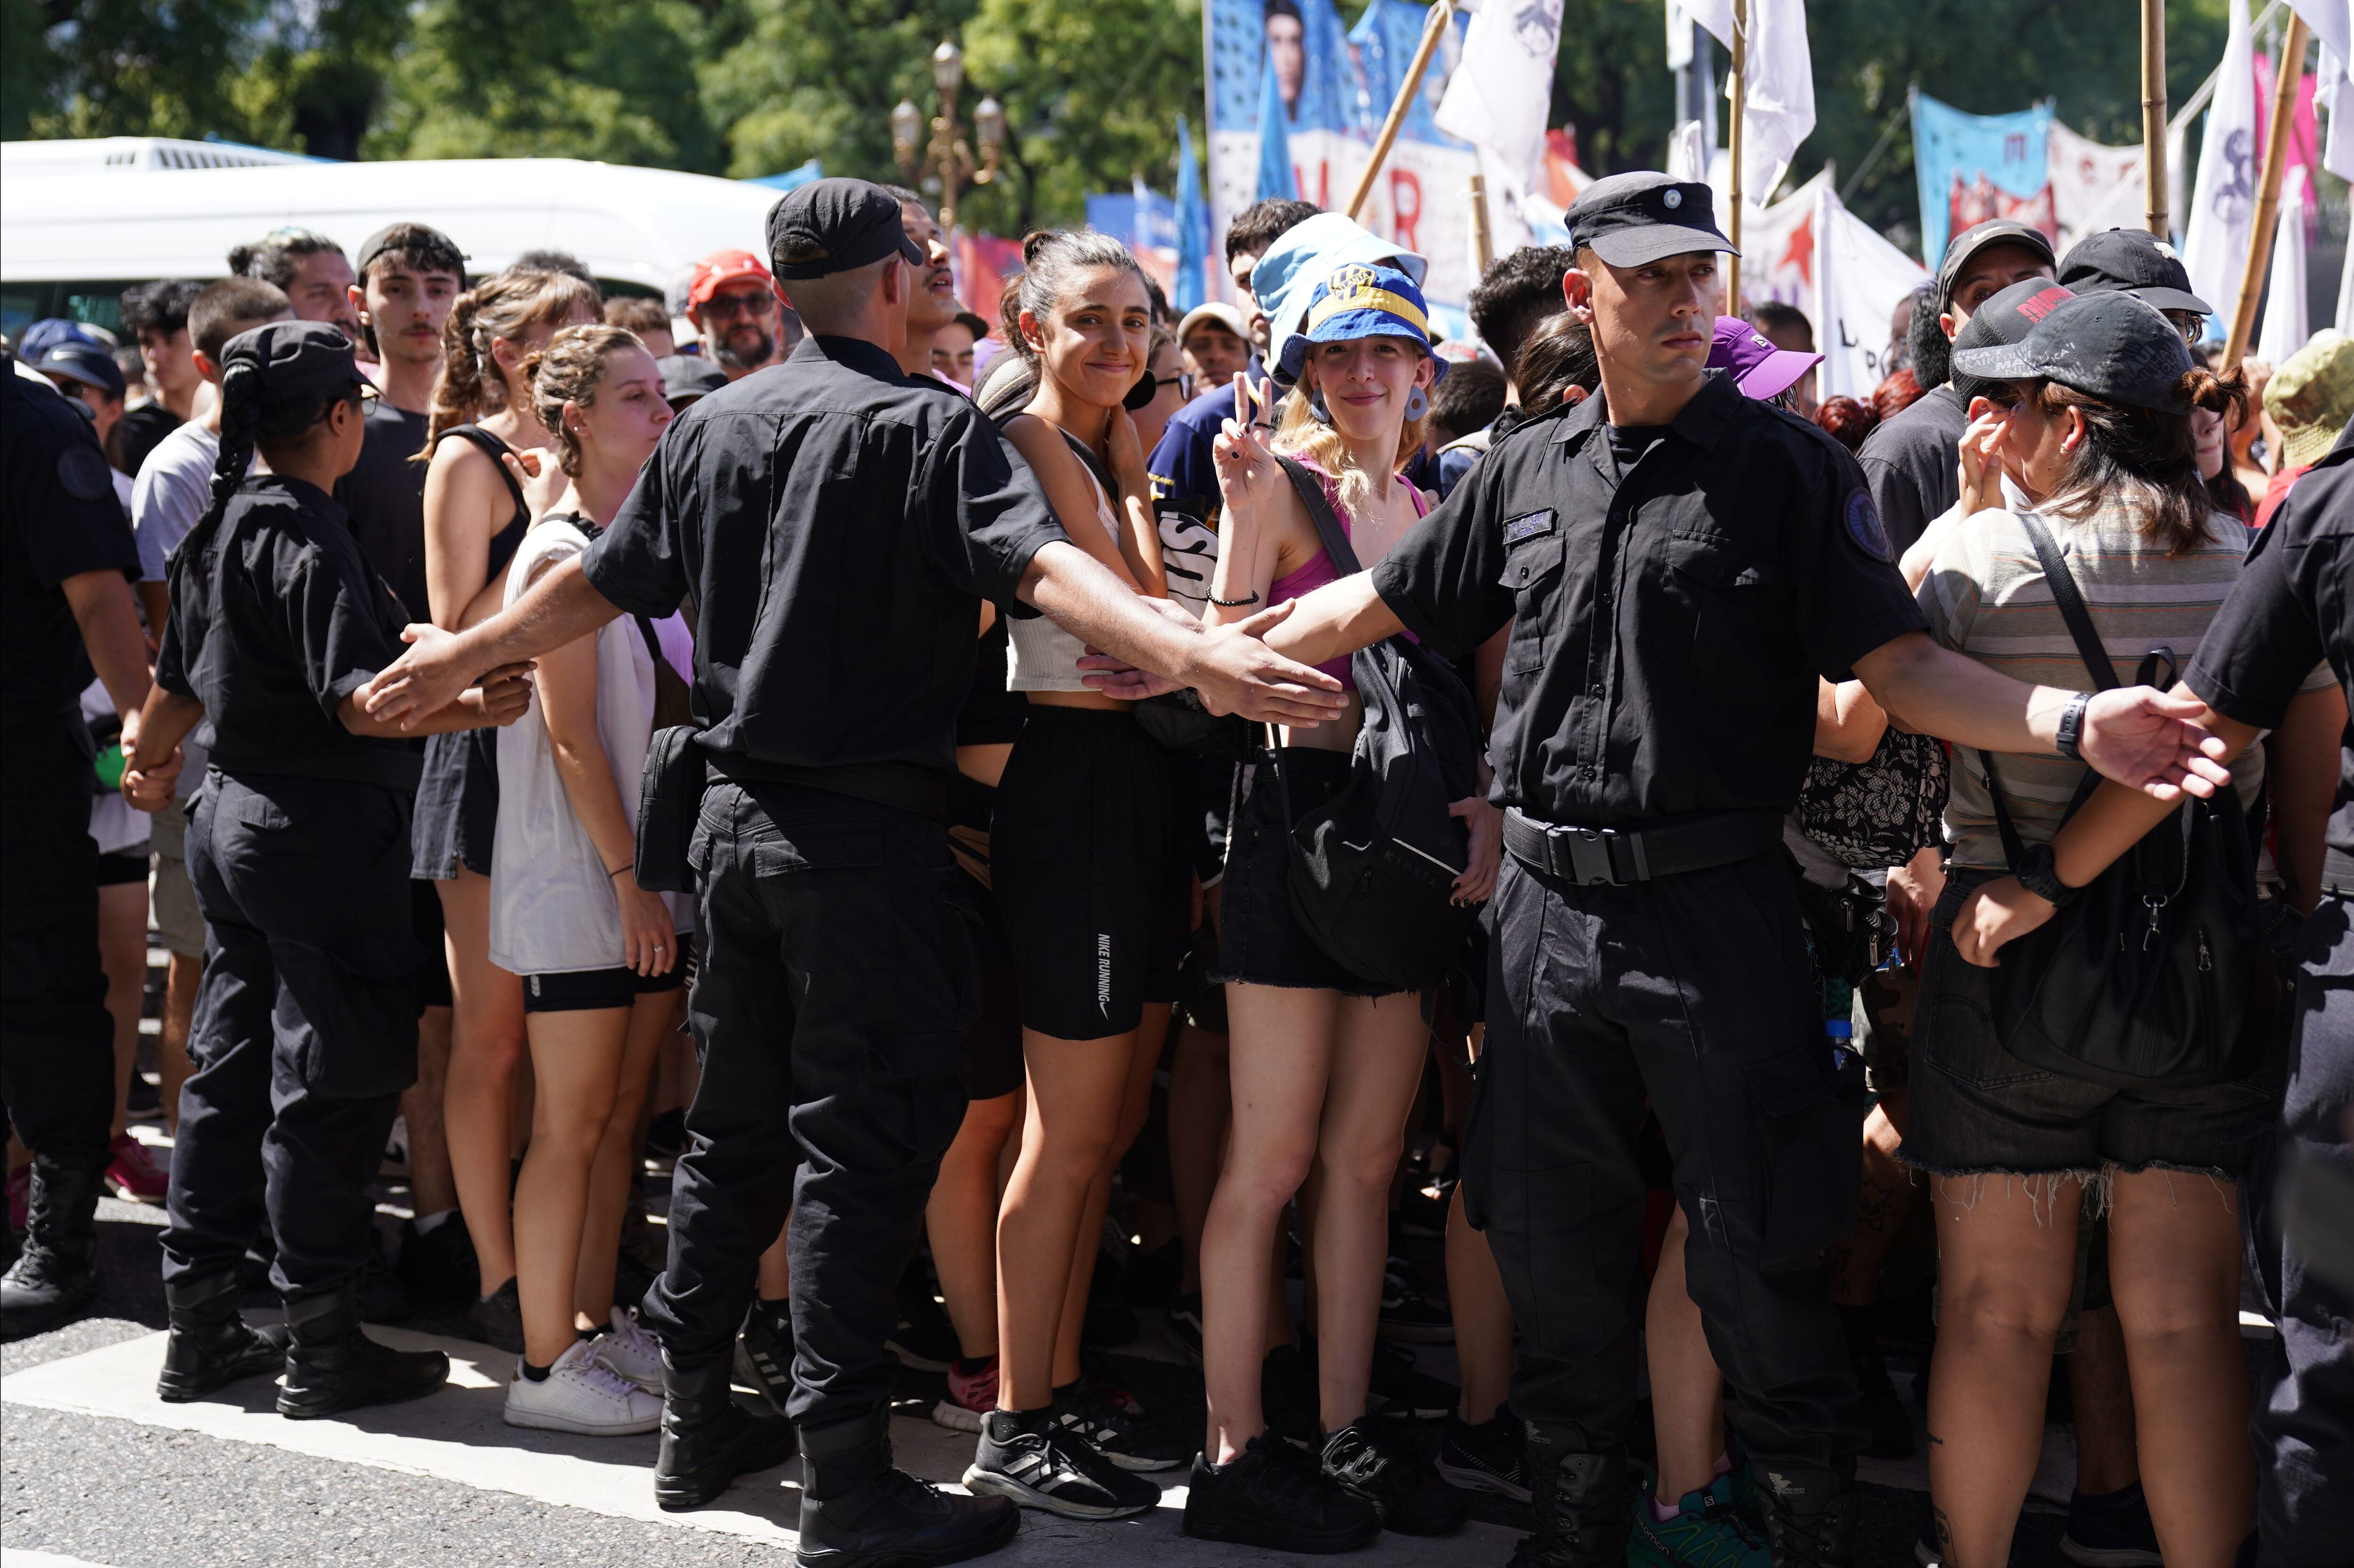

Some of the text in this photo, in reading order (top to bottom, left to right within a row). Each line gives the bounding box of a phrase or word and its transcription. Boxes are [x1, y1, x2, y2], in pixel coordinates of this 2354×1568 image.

[1384, 851, 1436, 887] KIPSTA
[1098, 933, 1110, 1002] NIKE RUNNING
